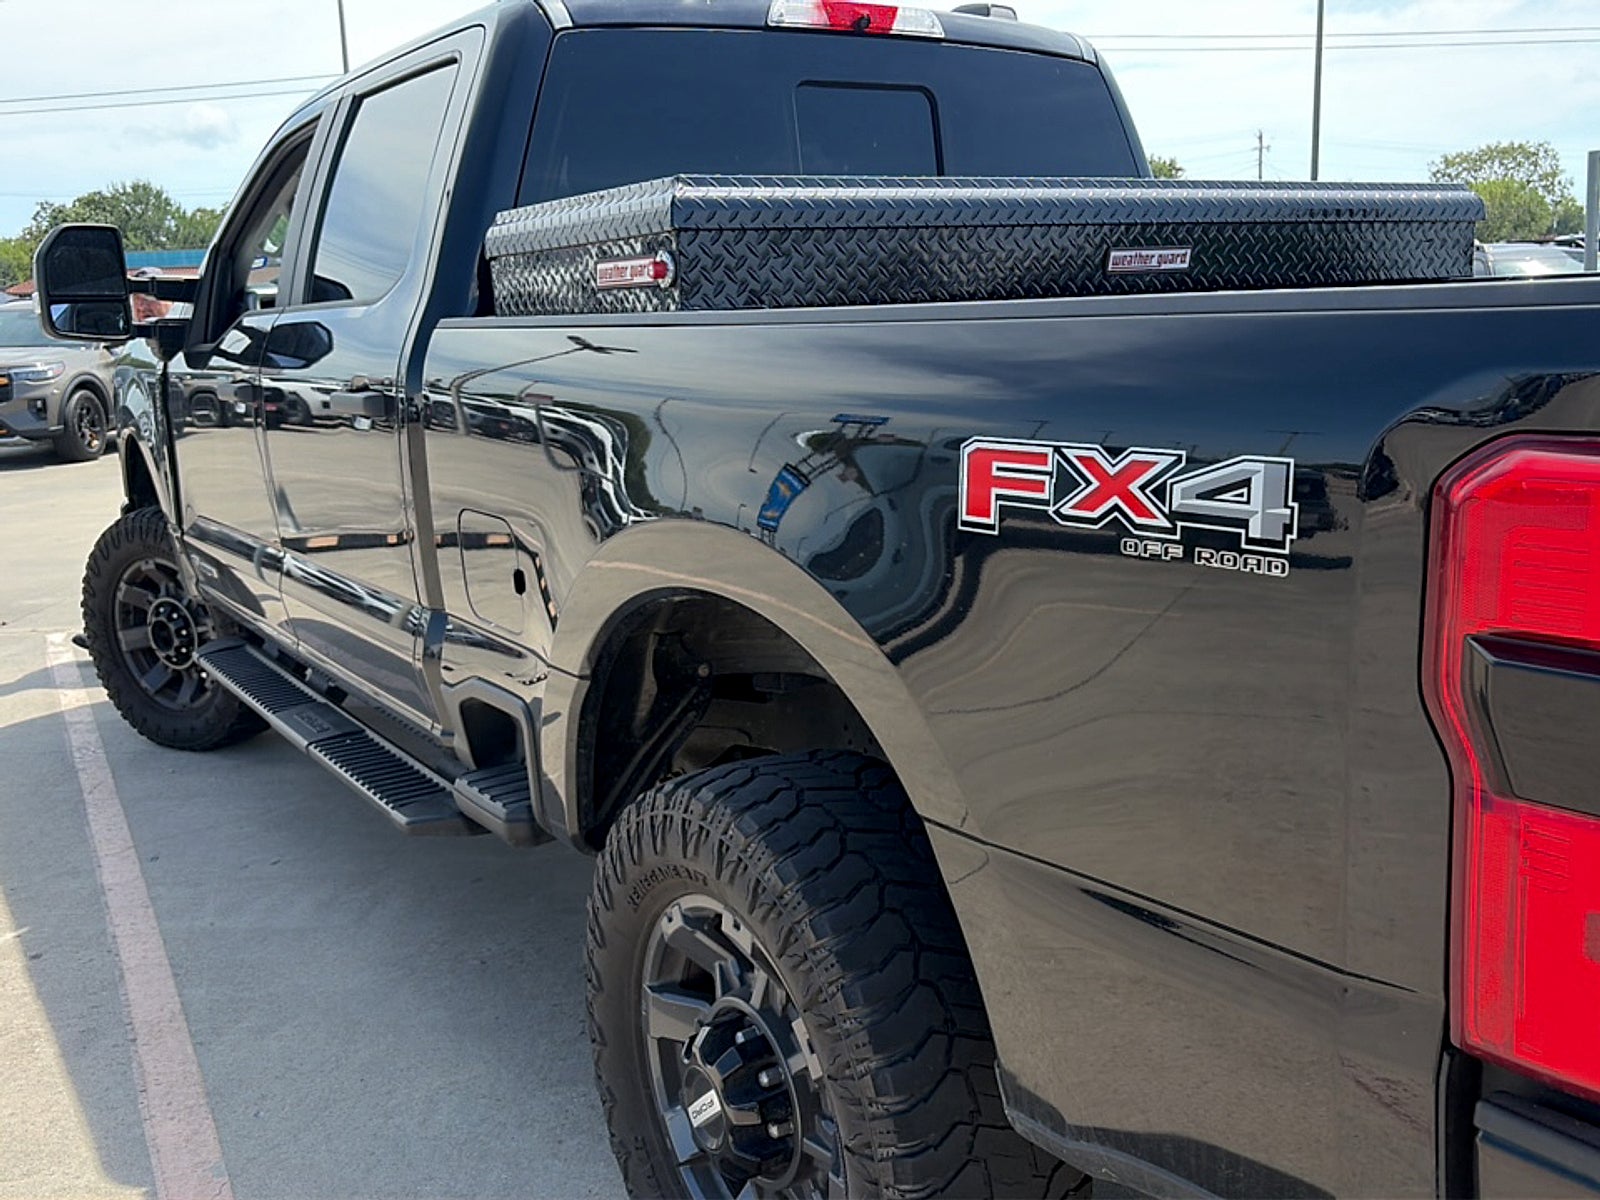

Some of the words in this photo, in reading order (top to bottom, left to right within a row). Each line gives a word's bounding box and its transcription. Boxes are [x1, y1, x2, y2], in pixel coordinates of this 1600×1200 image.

[1111, 250, 1156, 266] weather
[1157, 248, 1188, 267] guard
[960, 438, 1297, 552] FX4
[1120, 538, 1184, 560] OFF
[1194, 547, 1290, 577] ROAD
